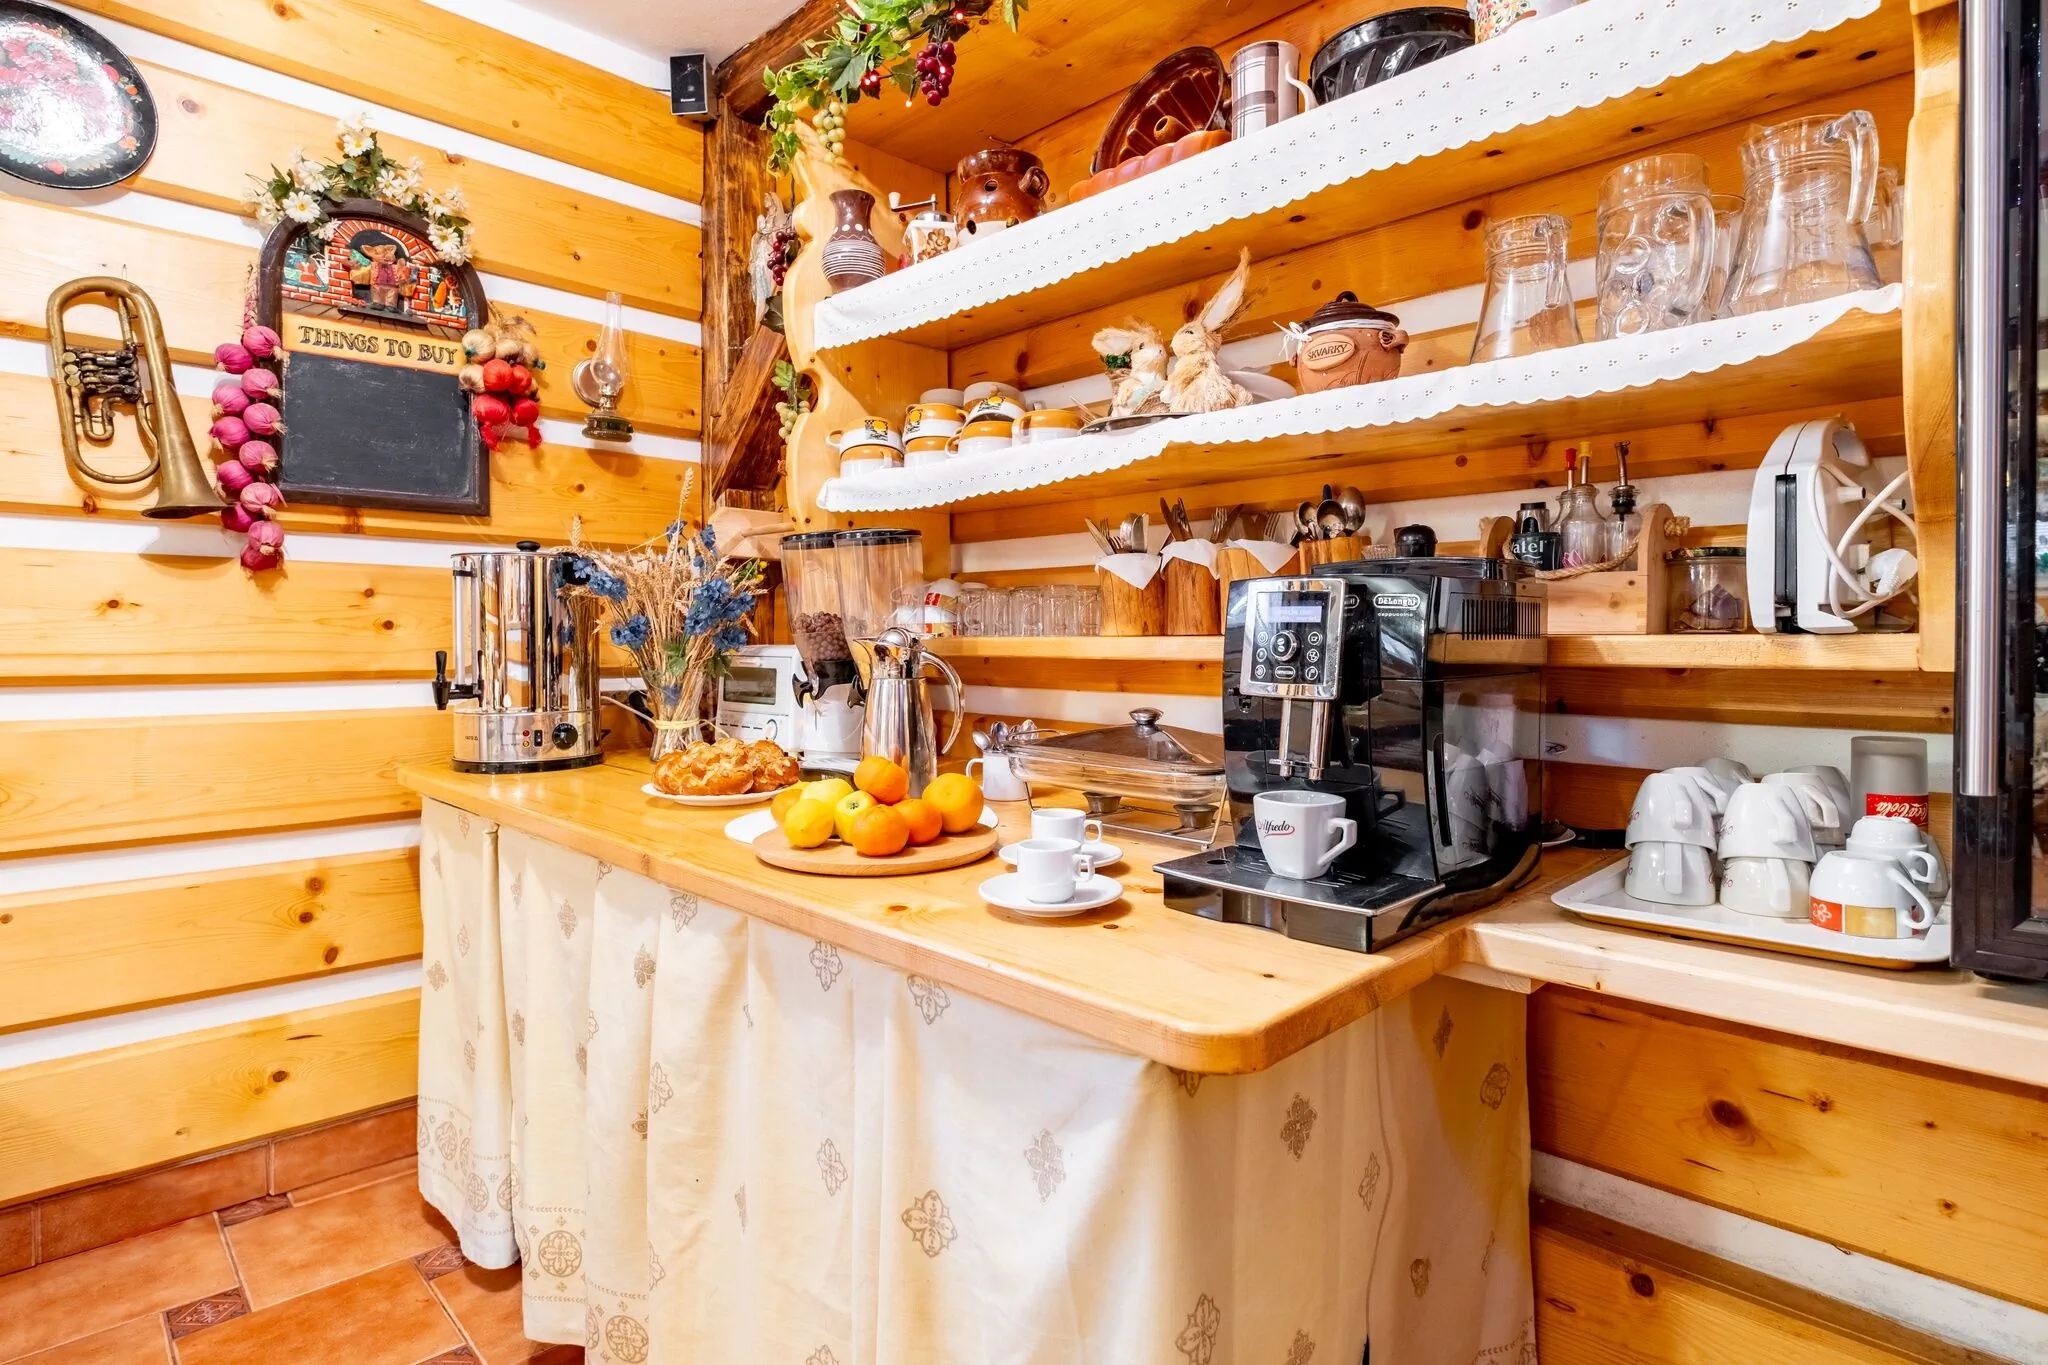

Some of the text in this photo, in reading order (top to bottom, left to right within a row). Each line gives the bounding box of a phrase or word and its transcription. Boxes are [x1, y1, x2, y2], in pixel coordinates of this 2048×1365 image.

[298, 325, 458, 365] THINGS TO BUY
